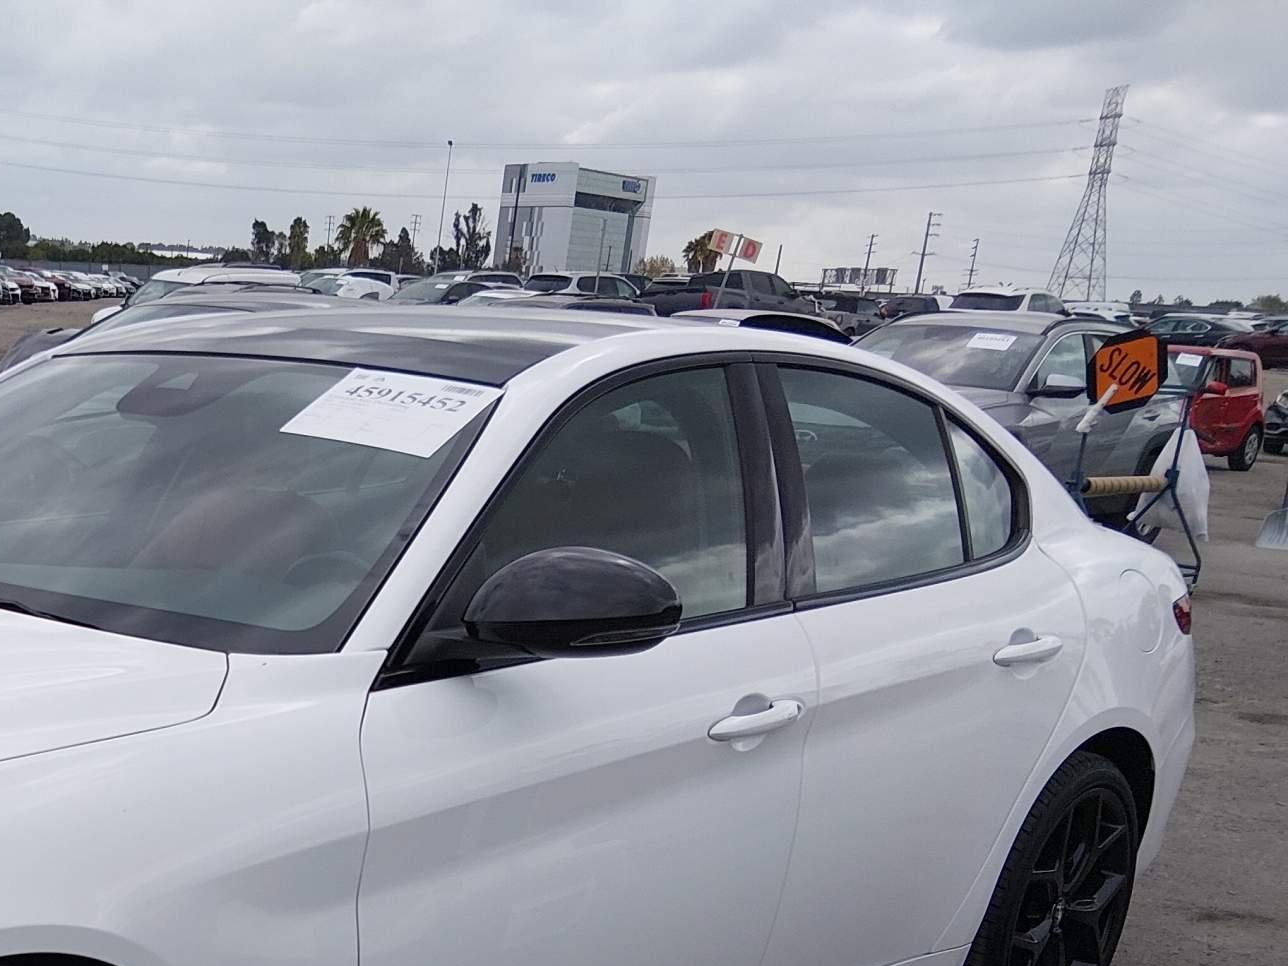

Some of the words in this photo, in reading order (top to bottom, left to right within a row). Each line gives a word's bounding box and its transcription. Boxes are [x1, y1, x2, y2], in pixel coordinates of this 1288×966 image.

[715, 232, 729, 250] E
[742, 240, 757, 259] D
[1099, 346, 1157, 395] SLOW
[344, 384, 467, 413] 45915452
